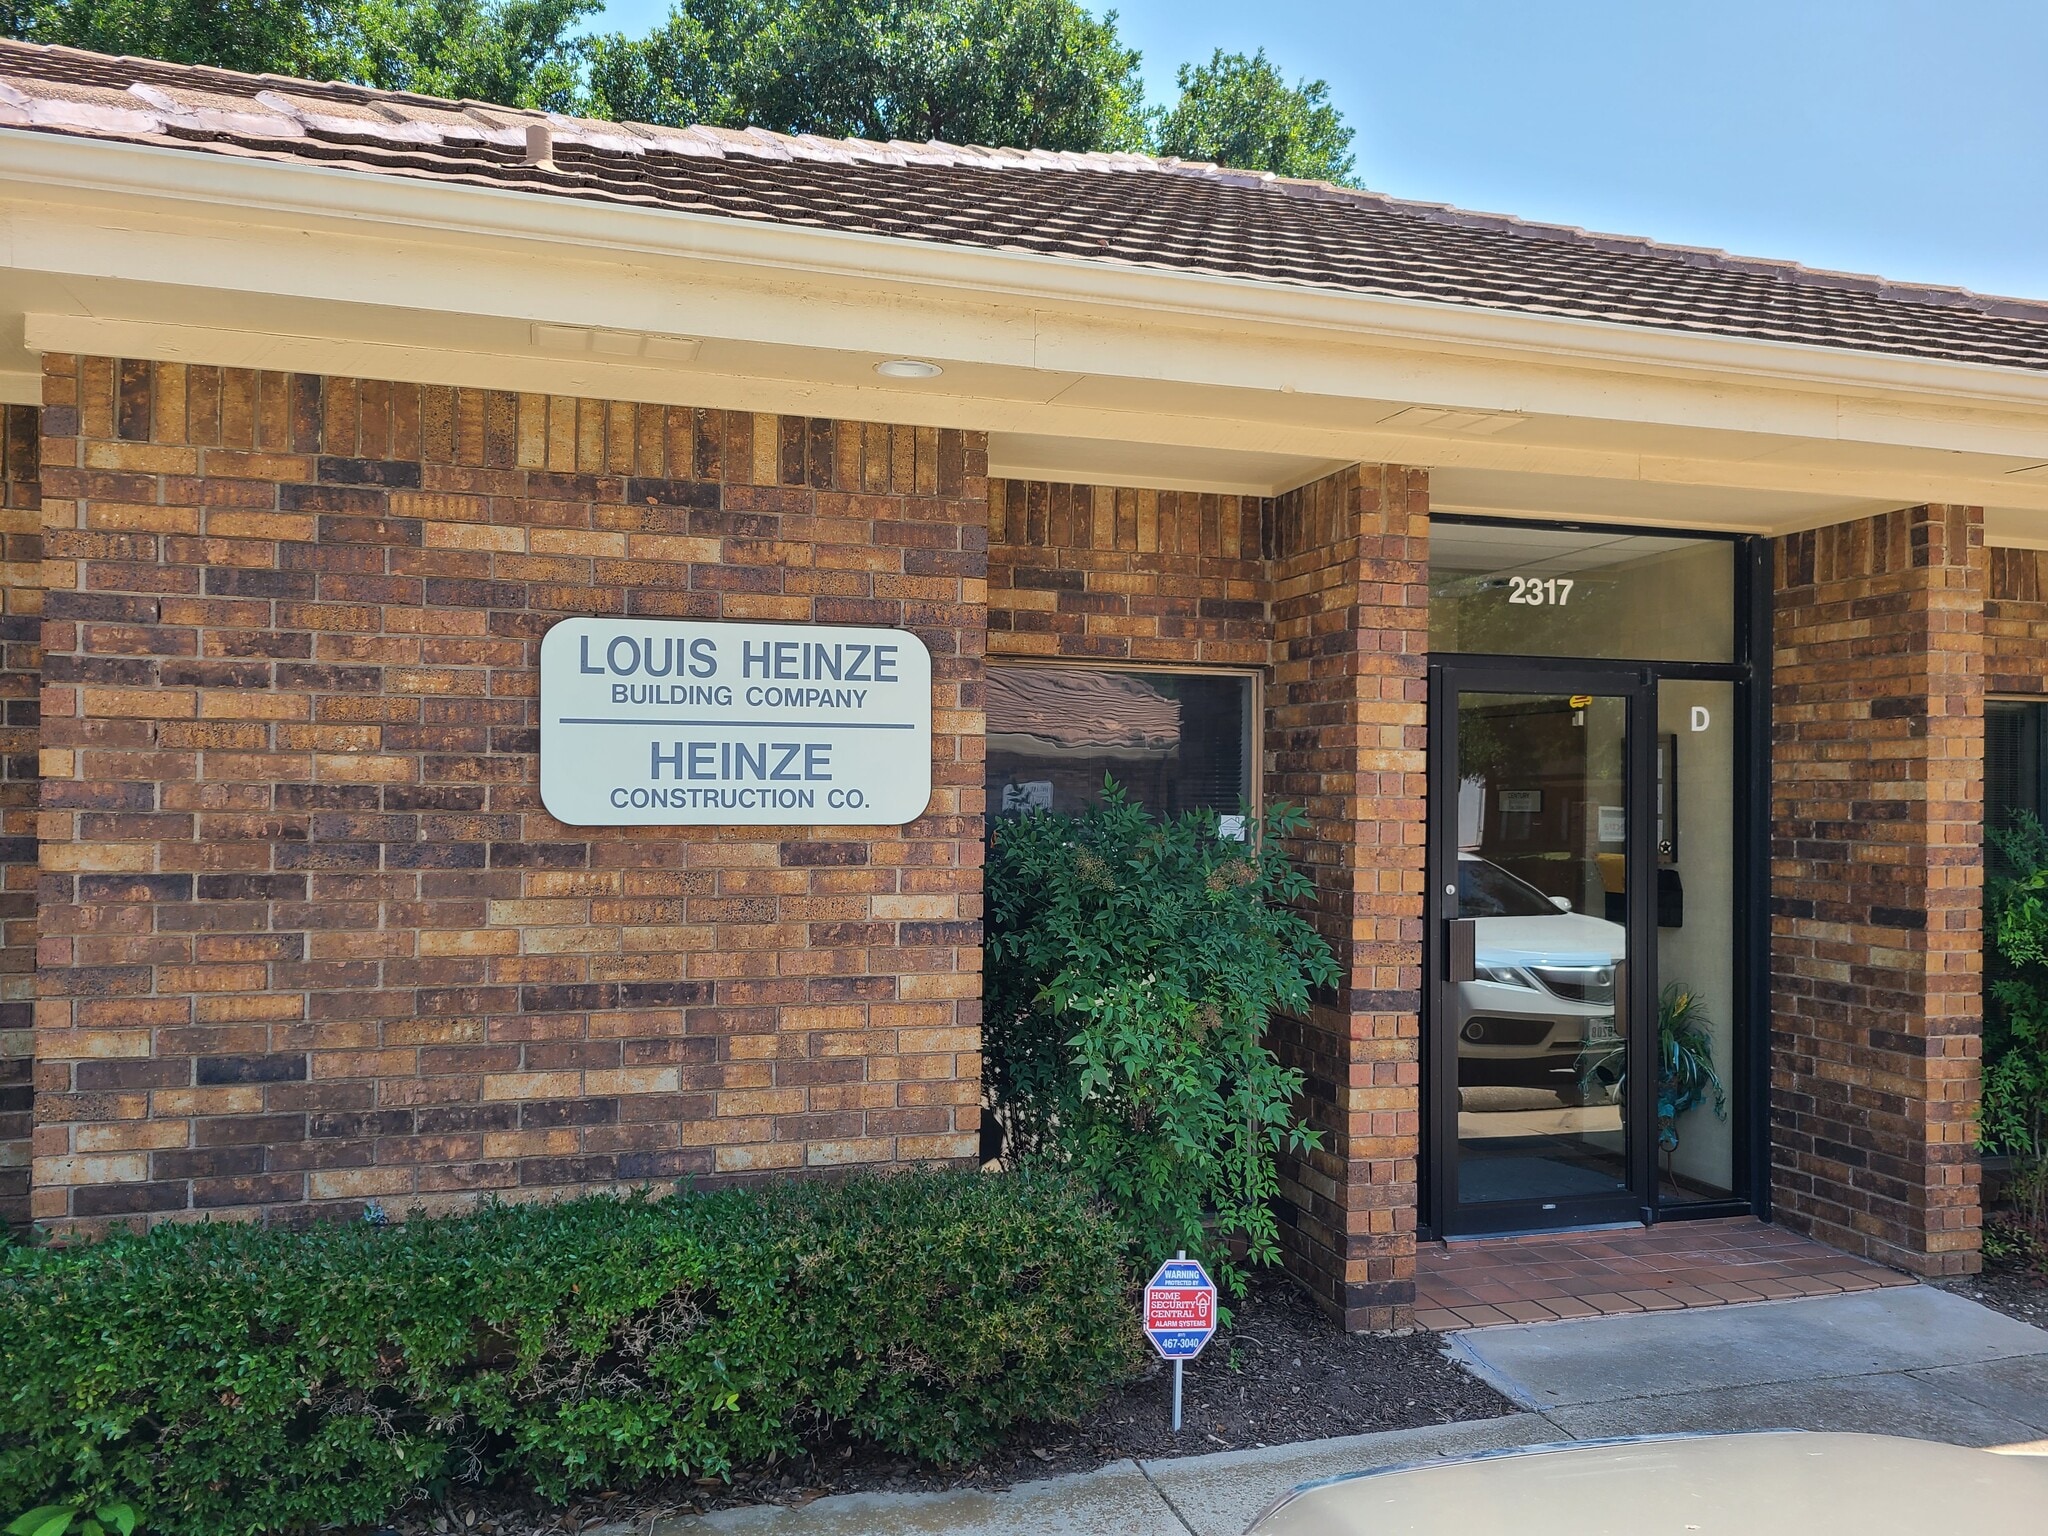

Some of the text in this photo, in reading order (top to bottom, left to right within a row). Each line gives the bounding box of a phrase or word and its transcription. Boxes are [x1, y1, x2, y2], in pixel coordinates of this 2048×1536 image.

[1508, 576, 1574, 606] 2317
[580, 635, 899, 682] LOUIS HEINZE
[611, 684, 868, 708] BUILDING COMPANY
[1691, 706, 1711, 732] D
[651, 741, 833, 781] HEINZE
[609, 787, 870, 809] CONSTRUCTION CO.
[1164, 1270, 1200, 1279] WARNING
[1151, 1292, 1180, 1300] HOME
[1151, 1301, 1196, 1309] SECURITY
[1151, 1310, 1195, 1318] CENTRAL
[1162, 1339, 1199, 1348] 467-3040
